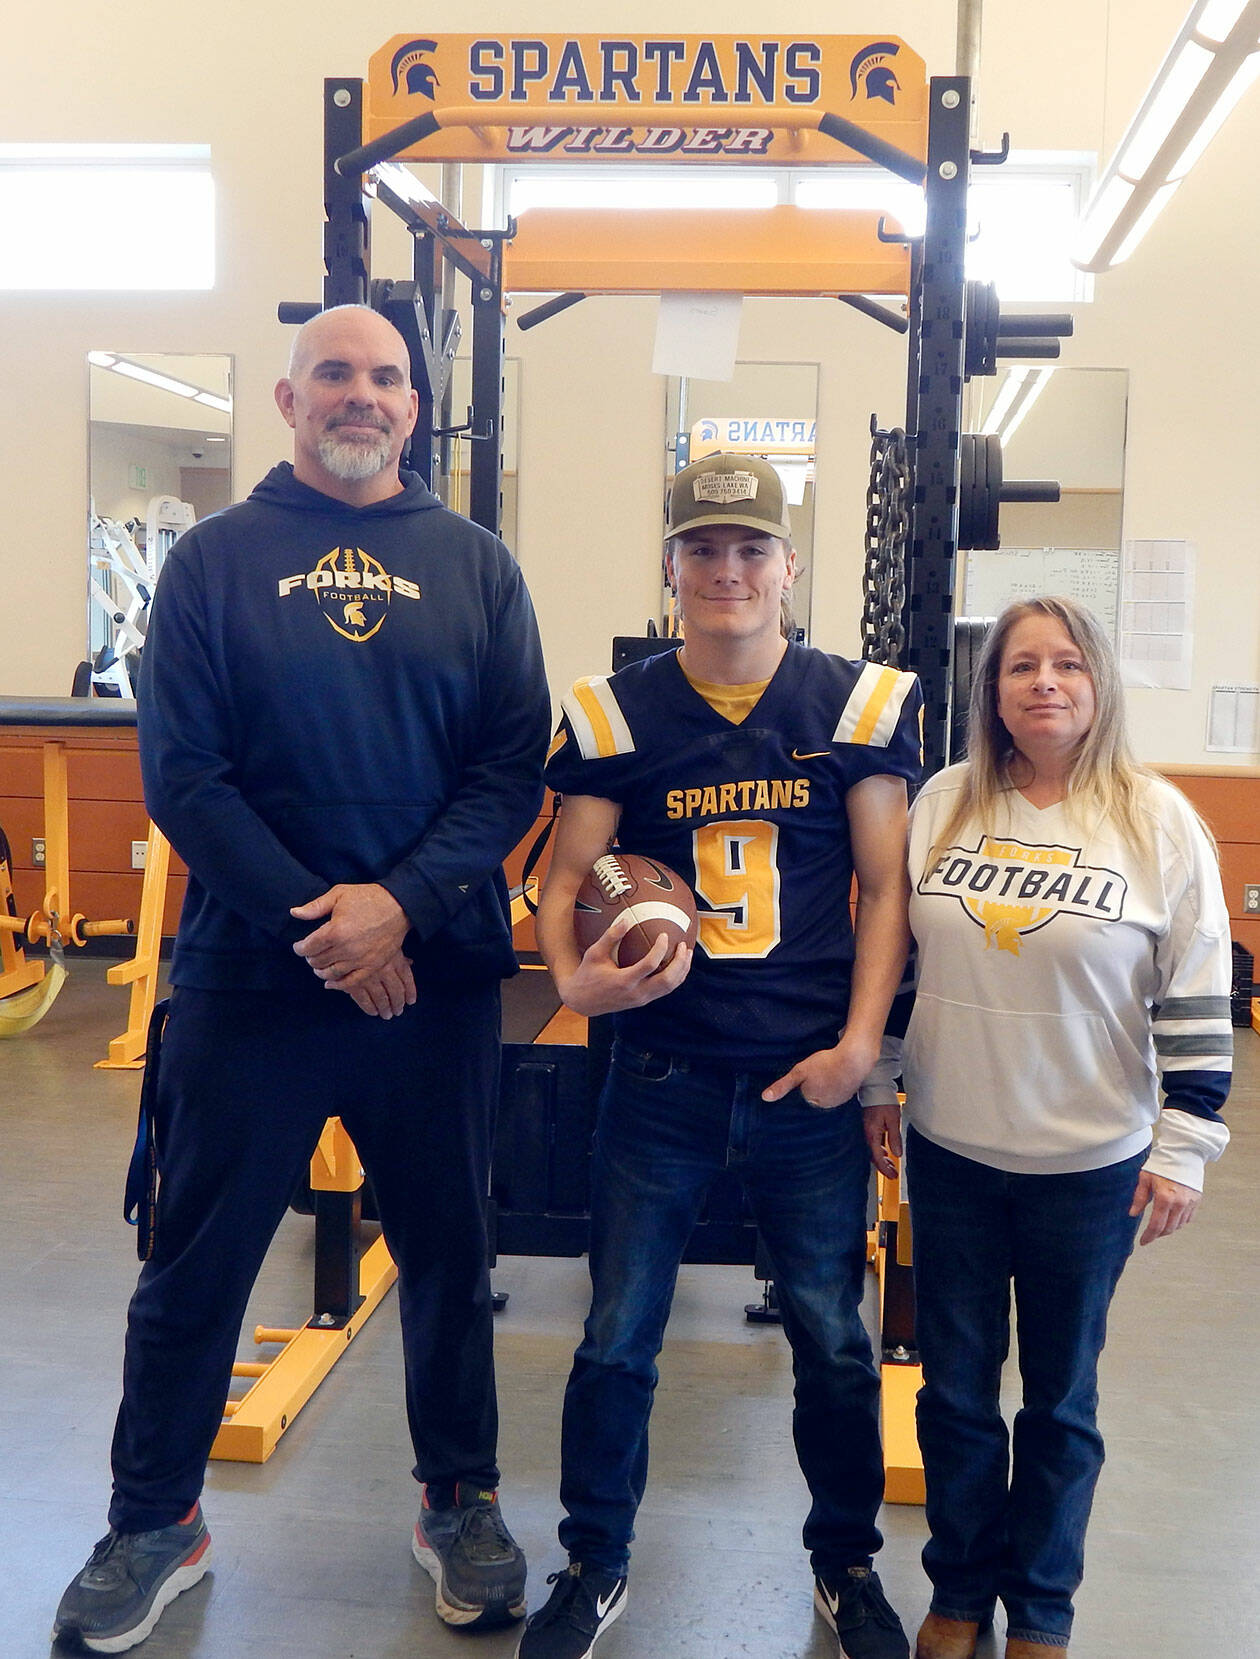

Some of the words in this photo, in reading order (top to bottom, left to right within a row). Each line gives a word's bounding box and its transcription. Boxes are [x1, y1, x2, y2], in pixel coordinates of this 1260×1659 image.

[467, 39, 822, 105] SPARTANS
[506, 126, 774, 155] WILDER
[278, 570, 421, 600] FORKS
[323, 591, 384, 601] FOOTBALL
[666, 778, 811, 820] SPARTANS
[999, 846, 1054, 864] FORKS
[692, 818, 781, 960] 9
[924, 855, 1114, 913] FOOTBALL
